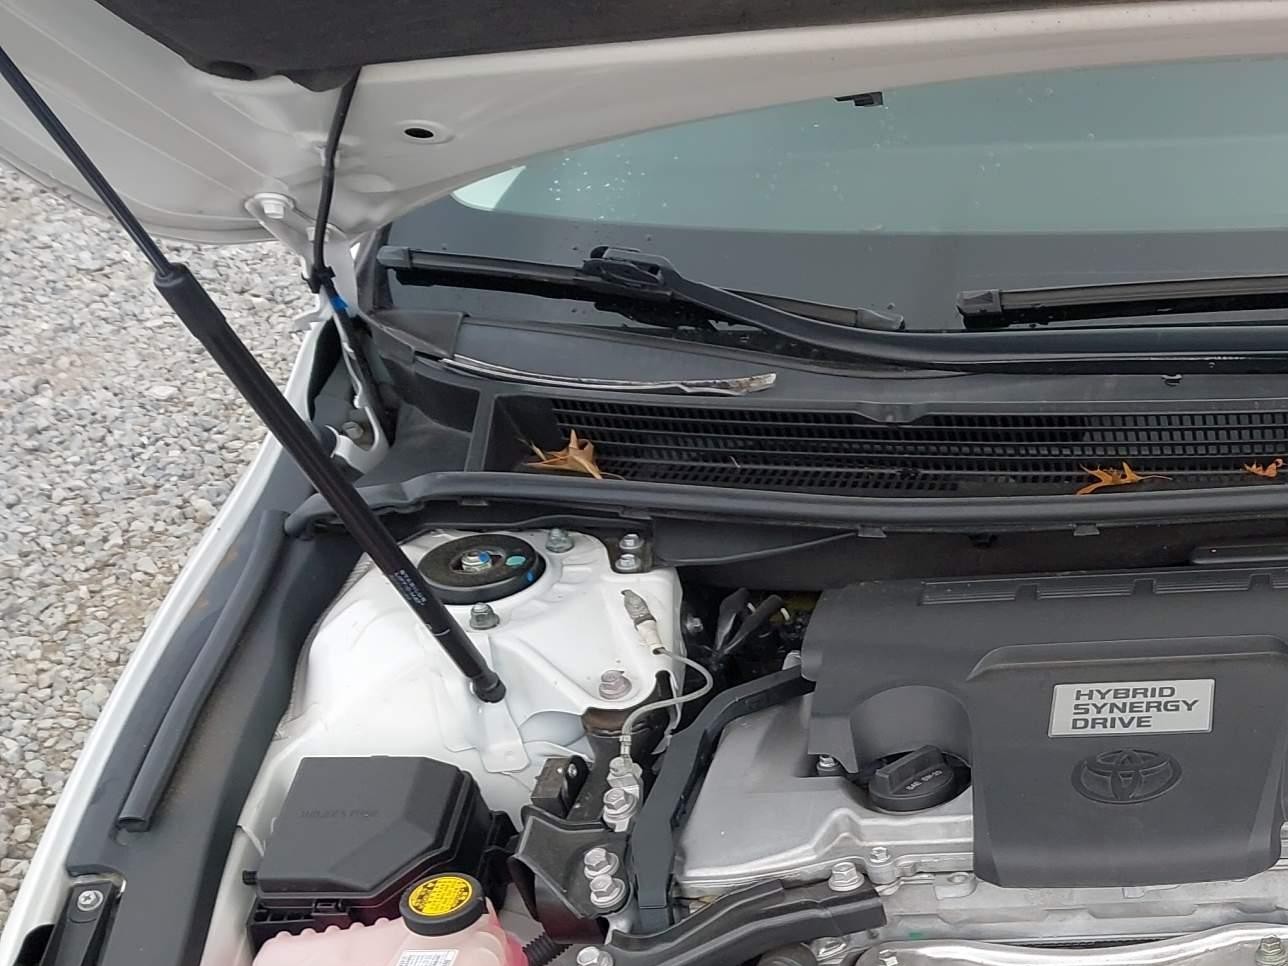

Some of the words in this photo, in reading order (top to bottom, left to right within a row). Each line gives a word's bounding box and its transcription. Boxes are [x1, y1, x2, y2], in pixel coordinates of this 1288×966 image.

[1075, 686, 1176, 701] HYBRID
[1072, 699, 1199, 716] SYNERGY
[1071, 715, 1153, 730] DRIVE
